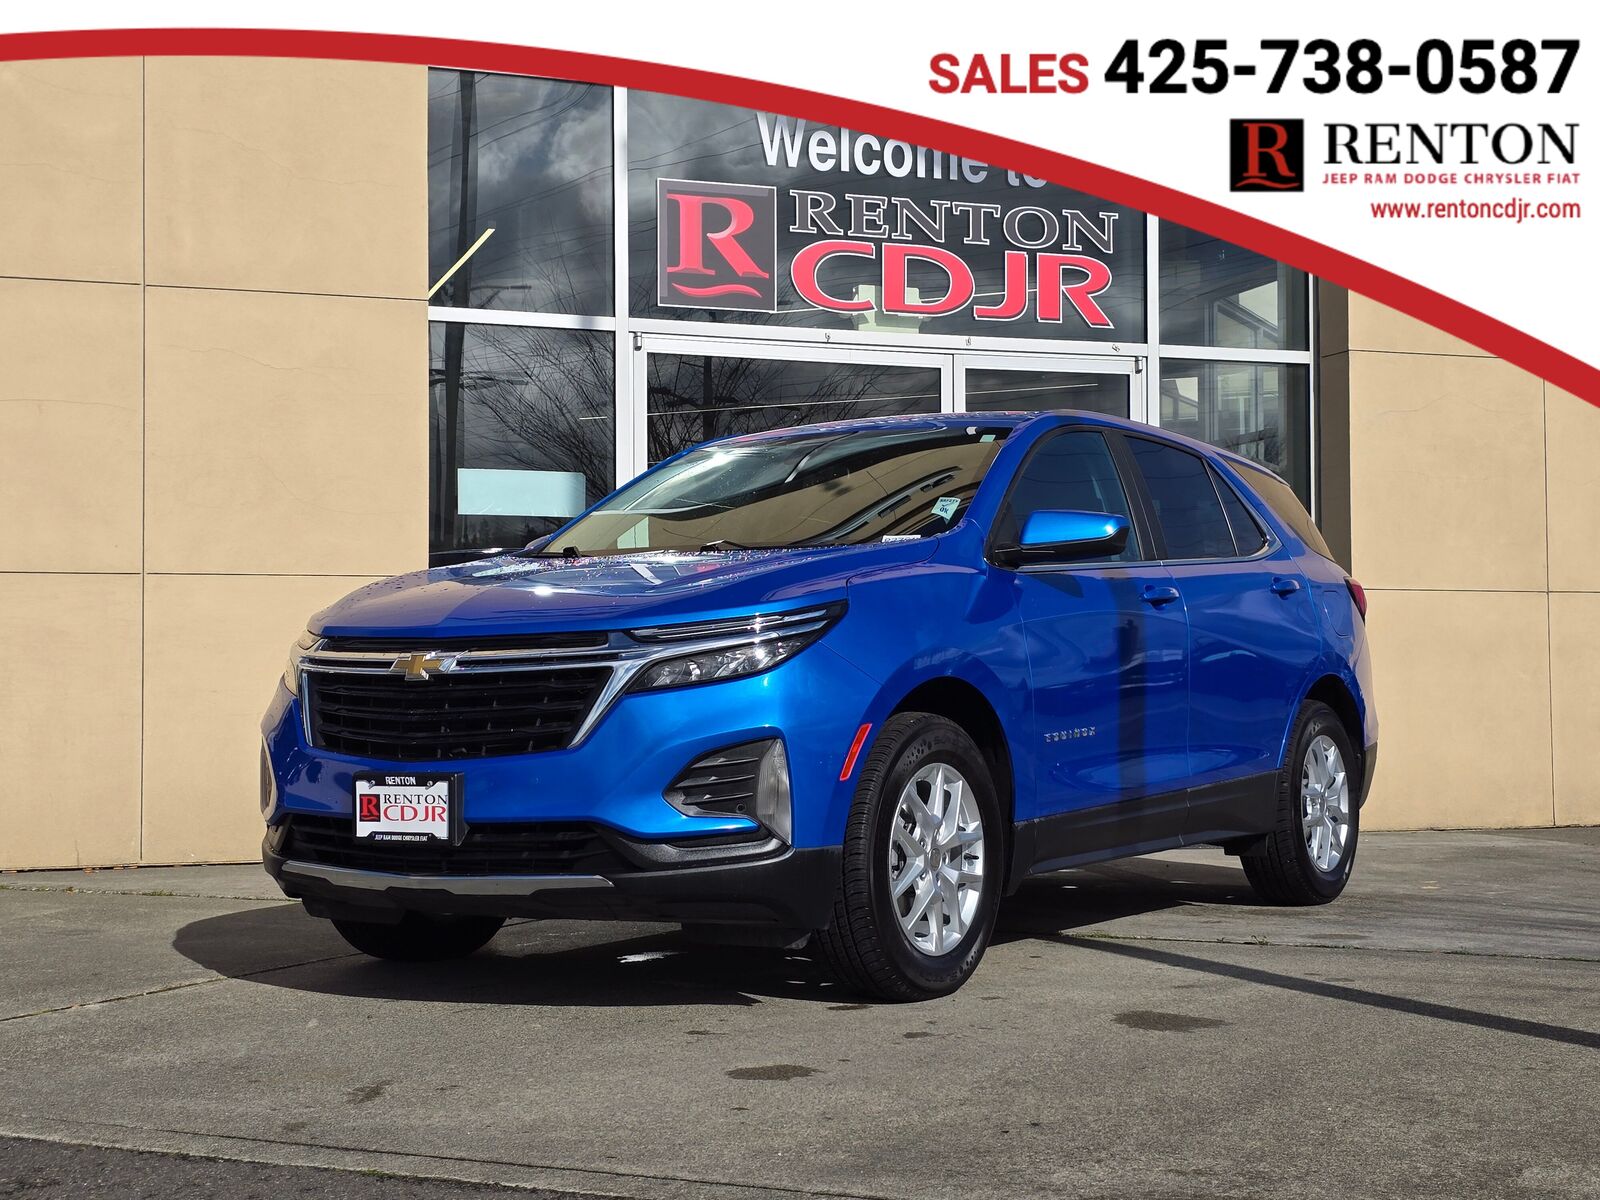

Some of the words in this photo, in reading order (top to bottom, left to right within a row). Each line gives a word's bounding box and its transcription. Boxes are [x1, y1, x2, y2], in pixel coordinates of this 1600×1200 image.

[756, 111, 988, 183] Welcome
[666, 193, 770, 279] R
[789, 189, 1119, 254] RENTON
[790, 239, 1115, 329] CDJR
[383, 794, 448, 805] RENTON
[385, 776, 416, 785] RENTON
[361, 796, 379, 817] R
[383, 805, 447, 822] CDJR
